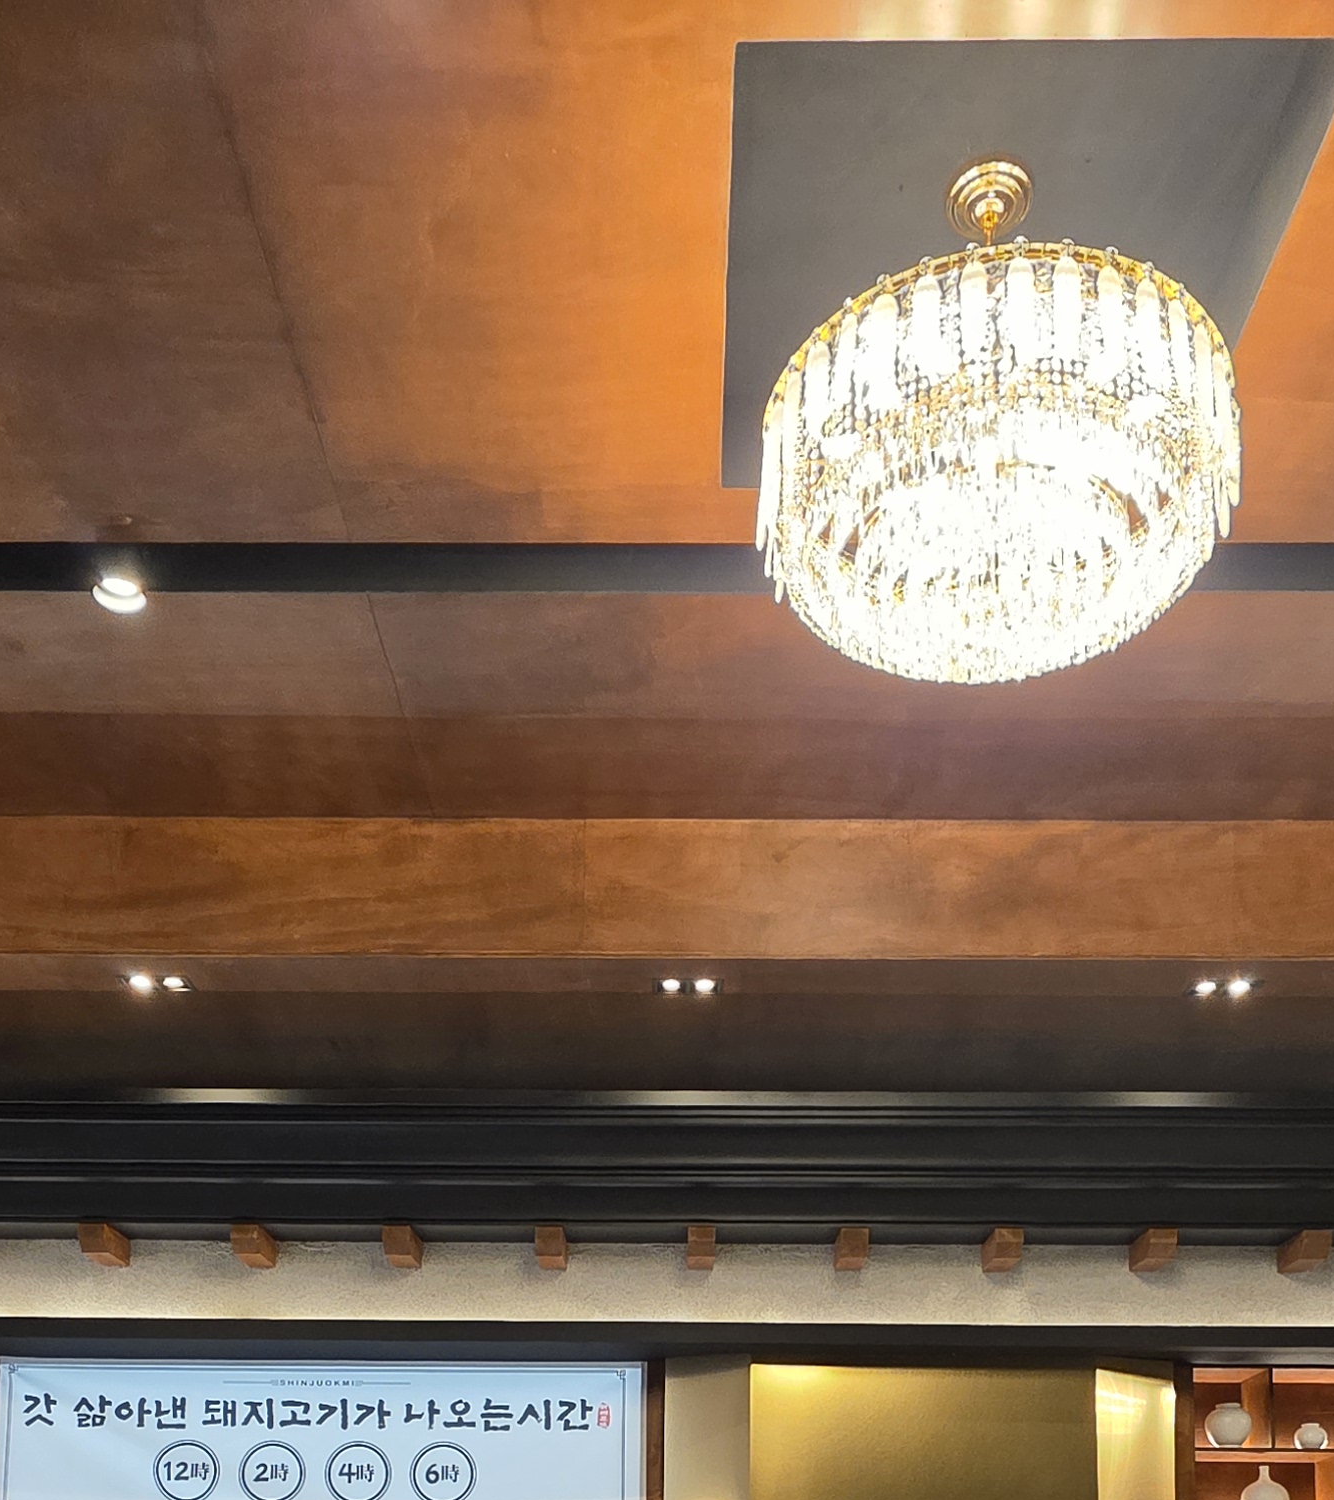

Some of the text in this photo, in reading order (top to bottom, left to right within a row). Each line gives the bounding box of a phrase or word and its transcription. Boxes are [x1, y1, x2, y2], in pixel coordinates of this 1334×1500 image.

[279, 1379, 355, 1387] SHINJUOKMI
[22, 1393, 57, 1426] 갓
[73, 1395, 187, 1430] 삶아낸
[202, 1398, 391, 1430] 돼지고기가
[163, 1461, 210, 1481] 12時
[253, 1463, 289, 1482] 2時
[338, 1463, 375, 1484] 4時
[425, 1463, 460, 1484] 6時
